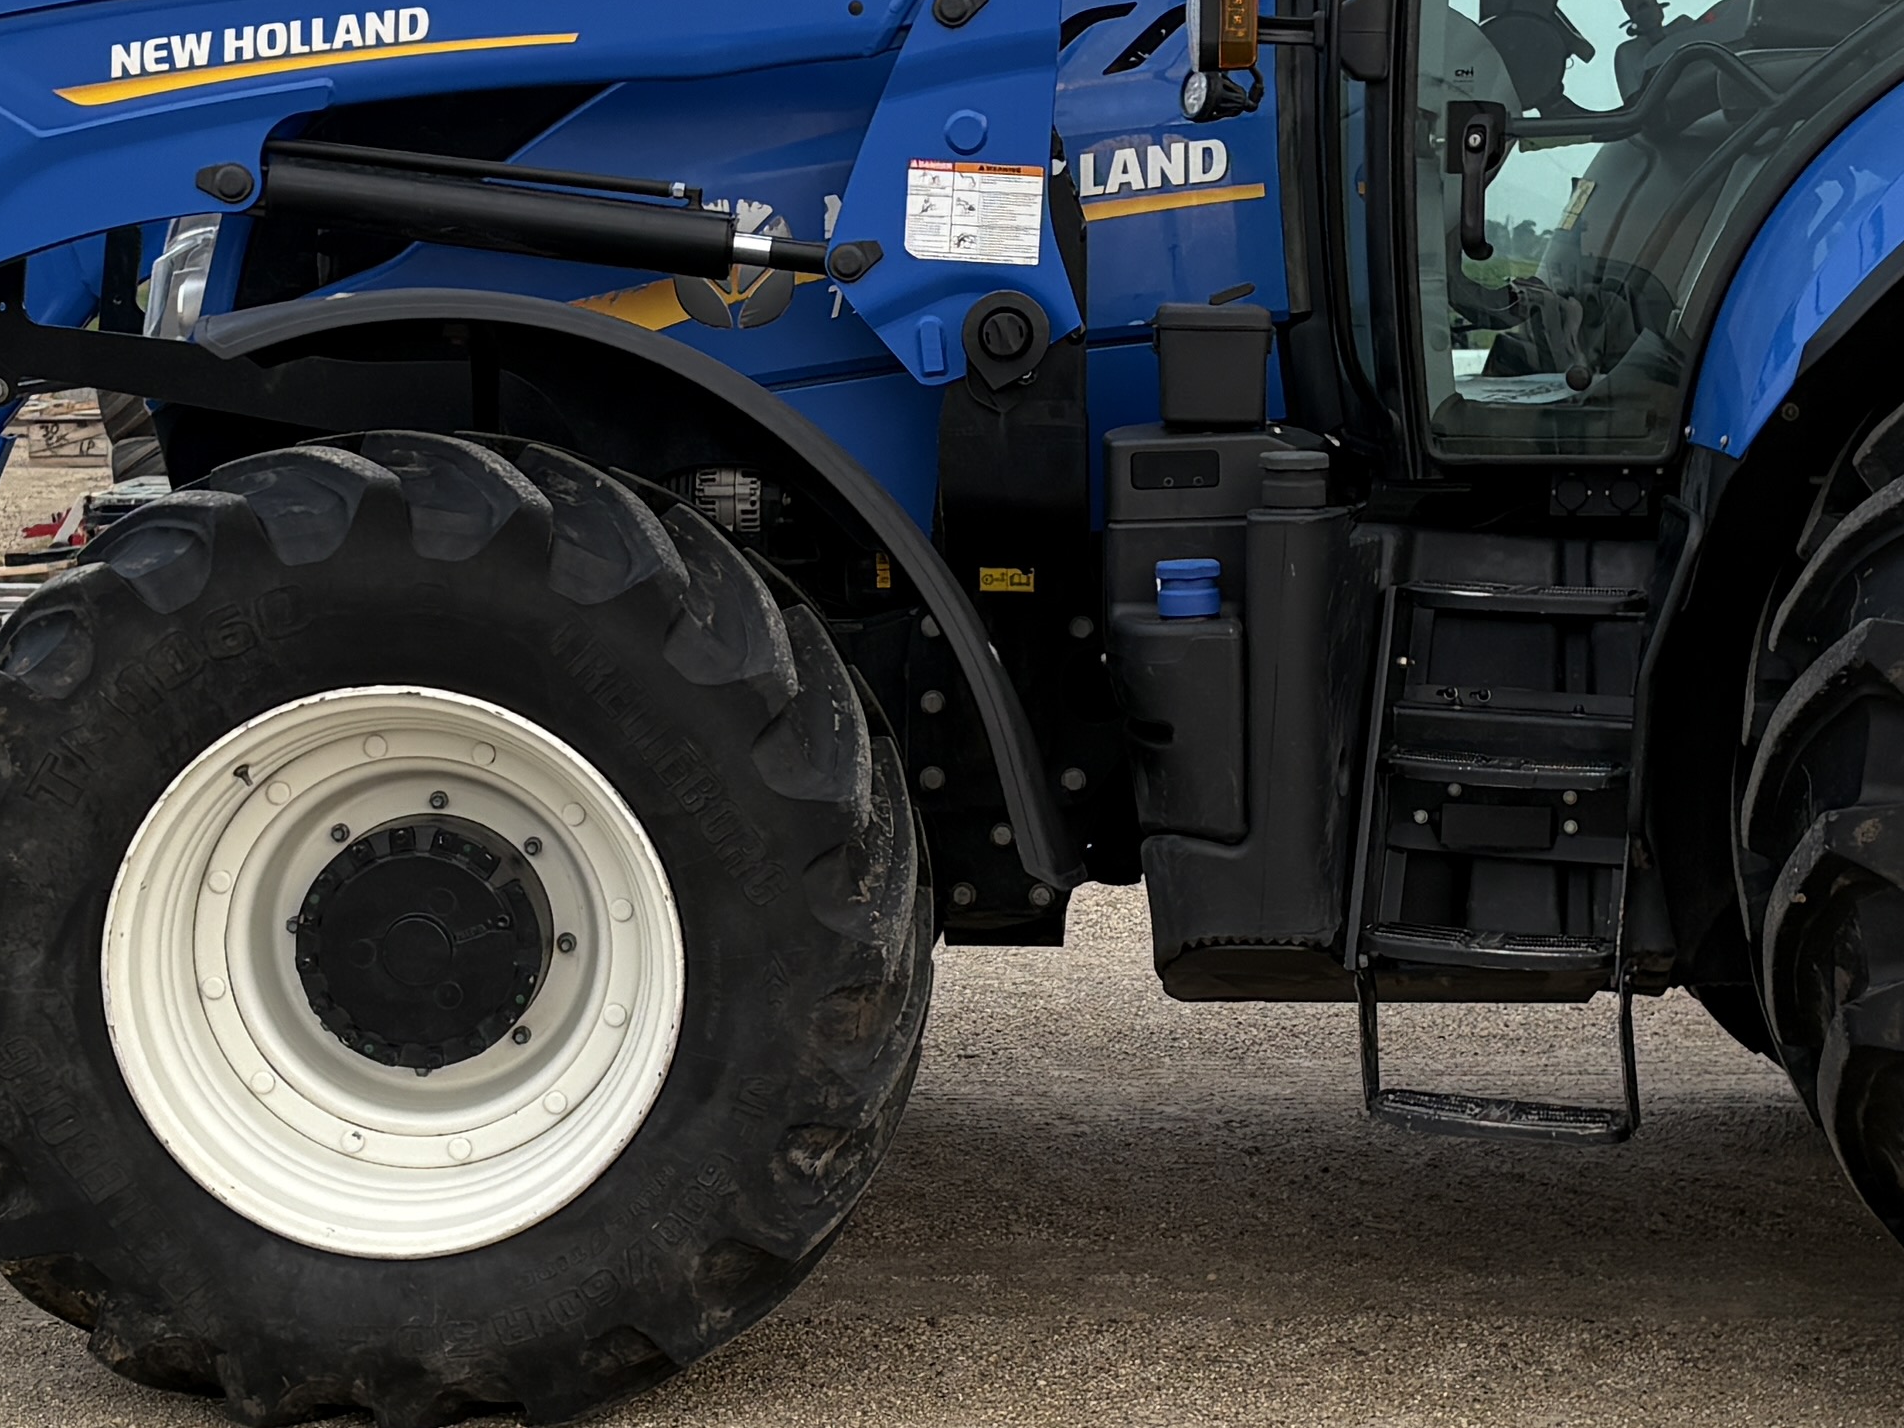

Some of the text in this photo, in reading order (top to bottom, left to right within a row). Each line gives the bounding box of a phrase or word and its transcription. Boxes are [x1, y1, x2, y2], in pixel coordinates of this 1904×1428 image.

[110, 6, 430, 79] NEW HOLLAND
[1079, 138, 1228, 198] LAND
[548, 608, 790, 907] TRELLEBORG
